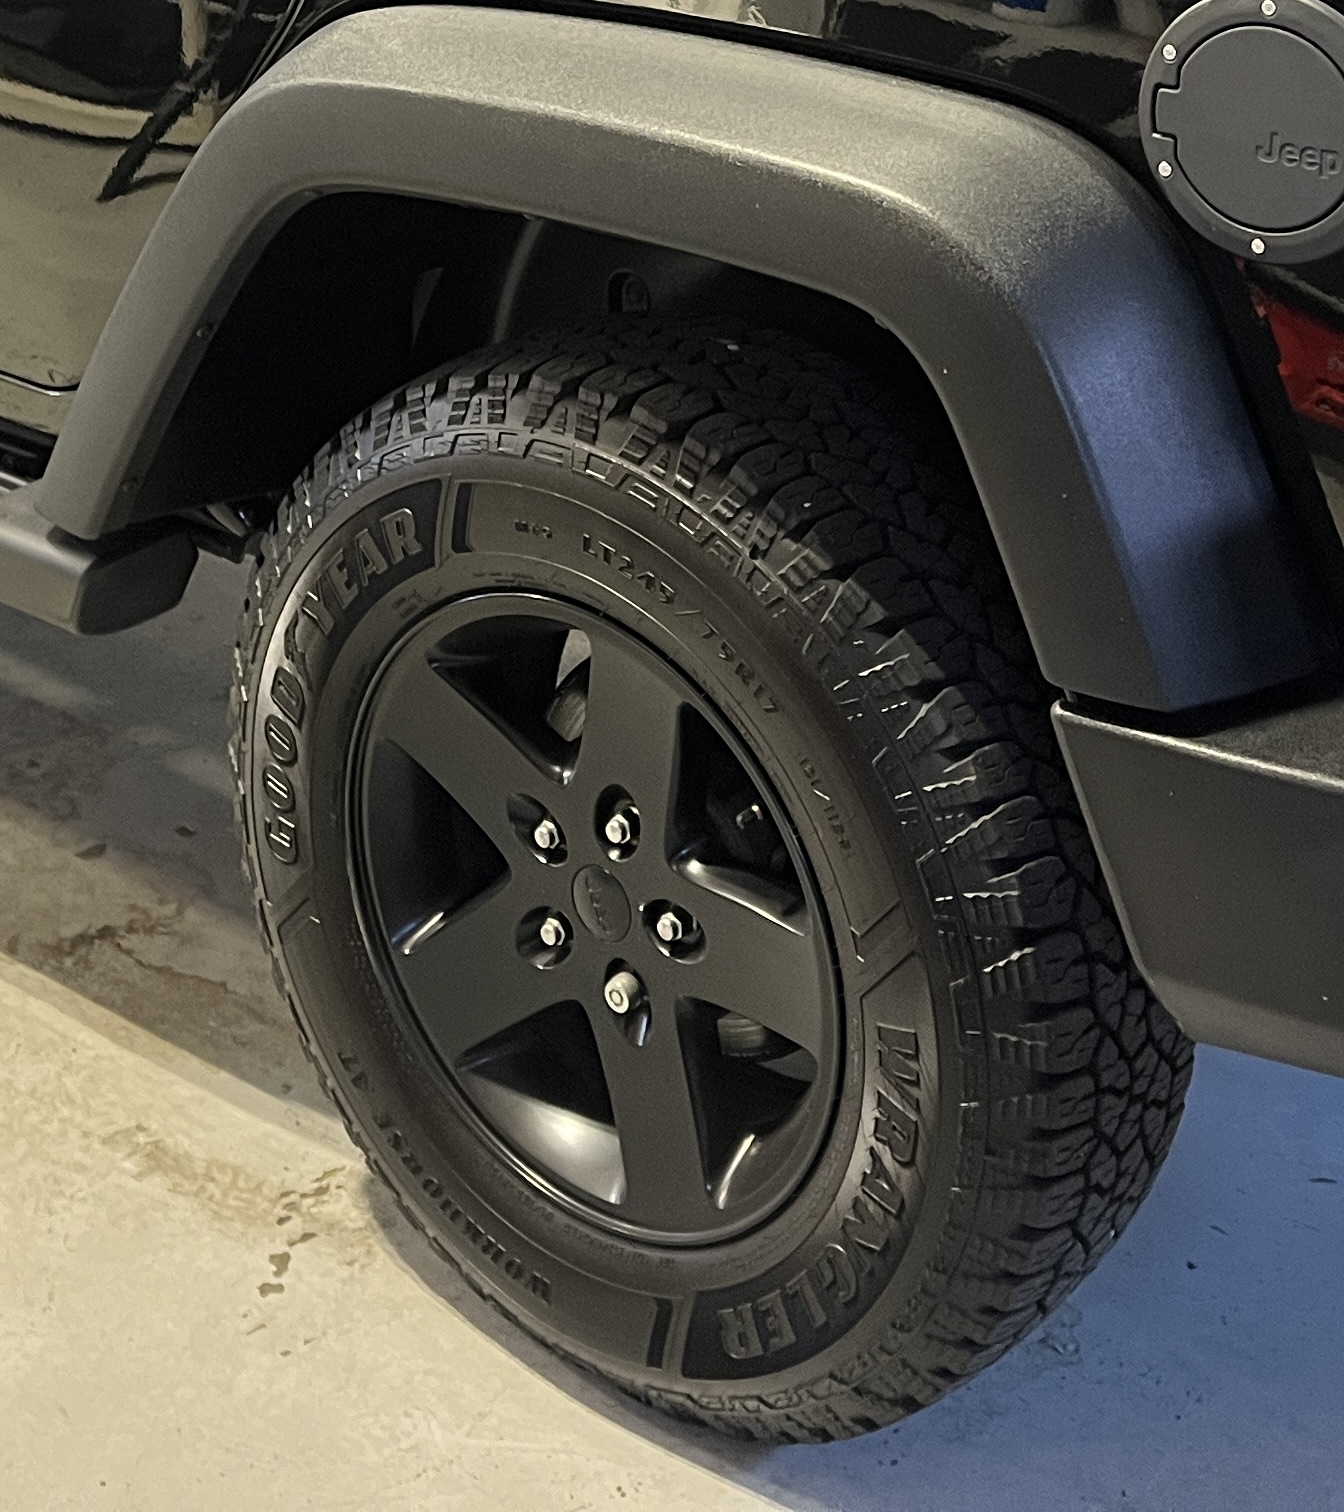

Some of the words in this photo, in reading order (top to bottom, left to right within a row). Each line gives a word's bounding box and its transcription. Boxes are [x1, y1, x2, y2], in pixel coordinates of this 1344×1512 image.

[1255, 131, 1343, 179] Jeep
[262, 507, 423, 865] GOODYEAR
[716, 1021, 921, 1360] WRANGLER
